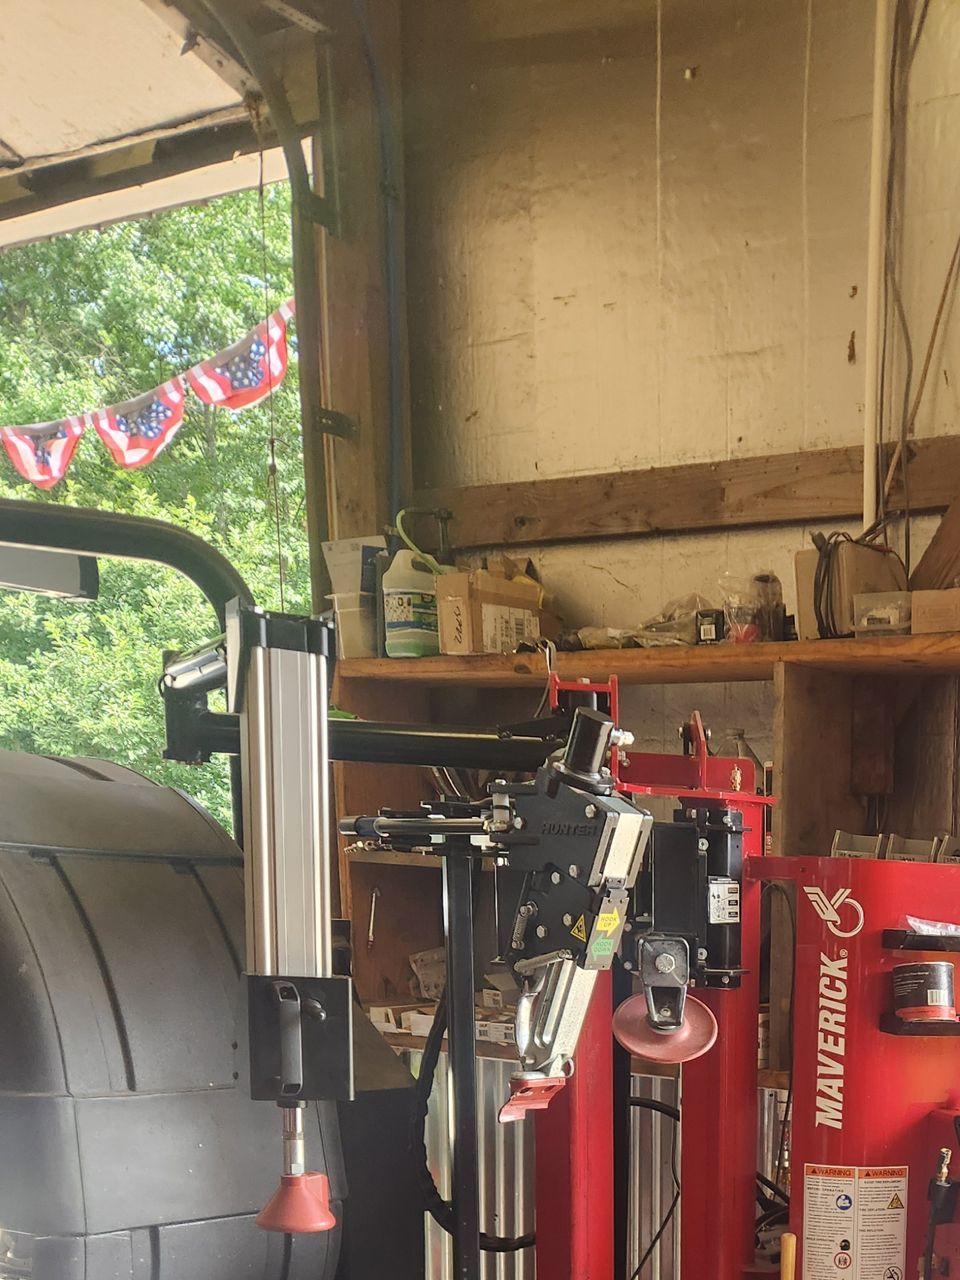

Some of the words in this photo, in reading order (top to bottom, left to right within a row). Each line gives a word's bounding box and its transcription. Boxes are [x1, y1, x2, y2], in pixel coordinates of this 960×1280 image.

[542, 823, 599, 837] HUNTER
[818, 1168, 852, 1177] WARNING
[871, 1169, 904, 1177] WARNING
